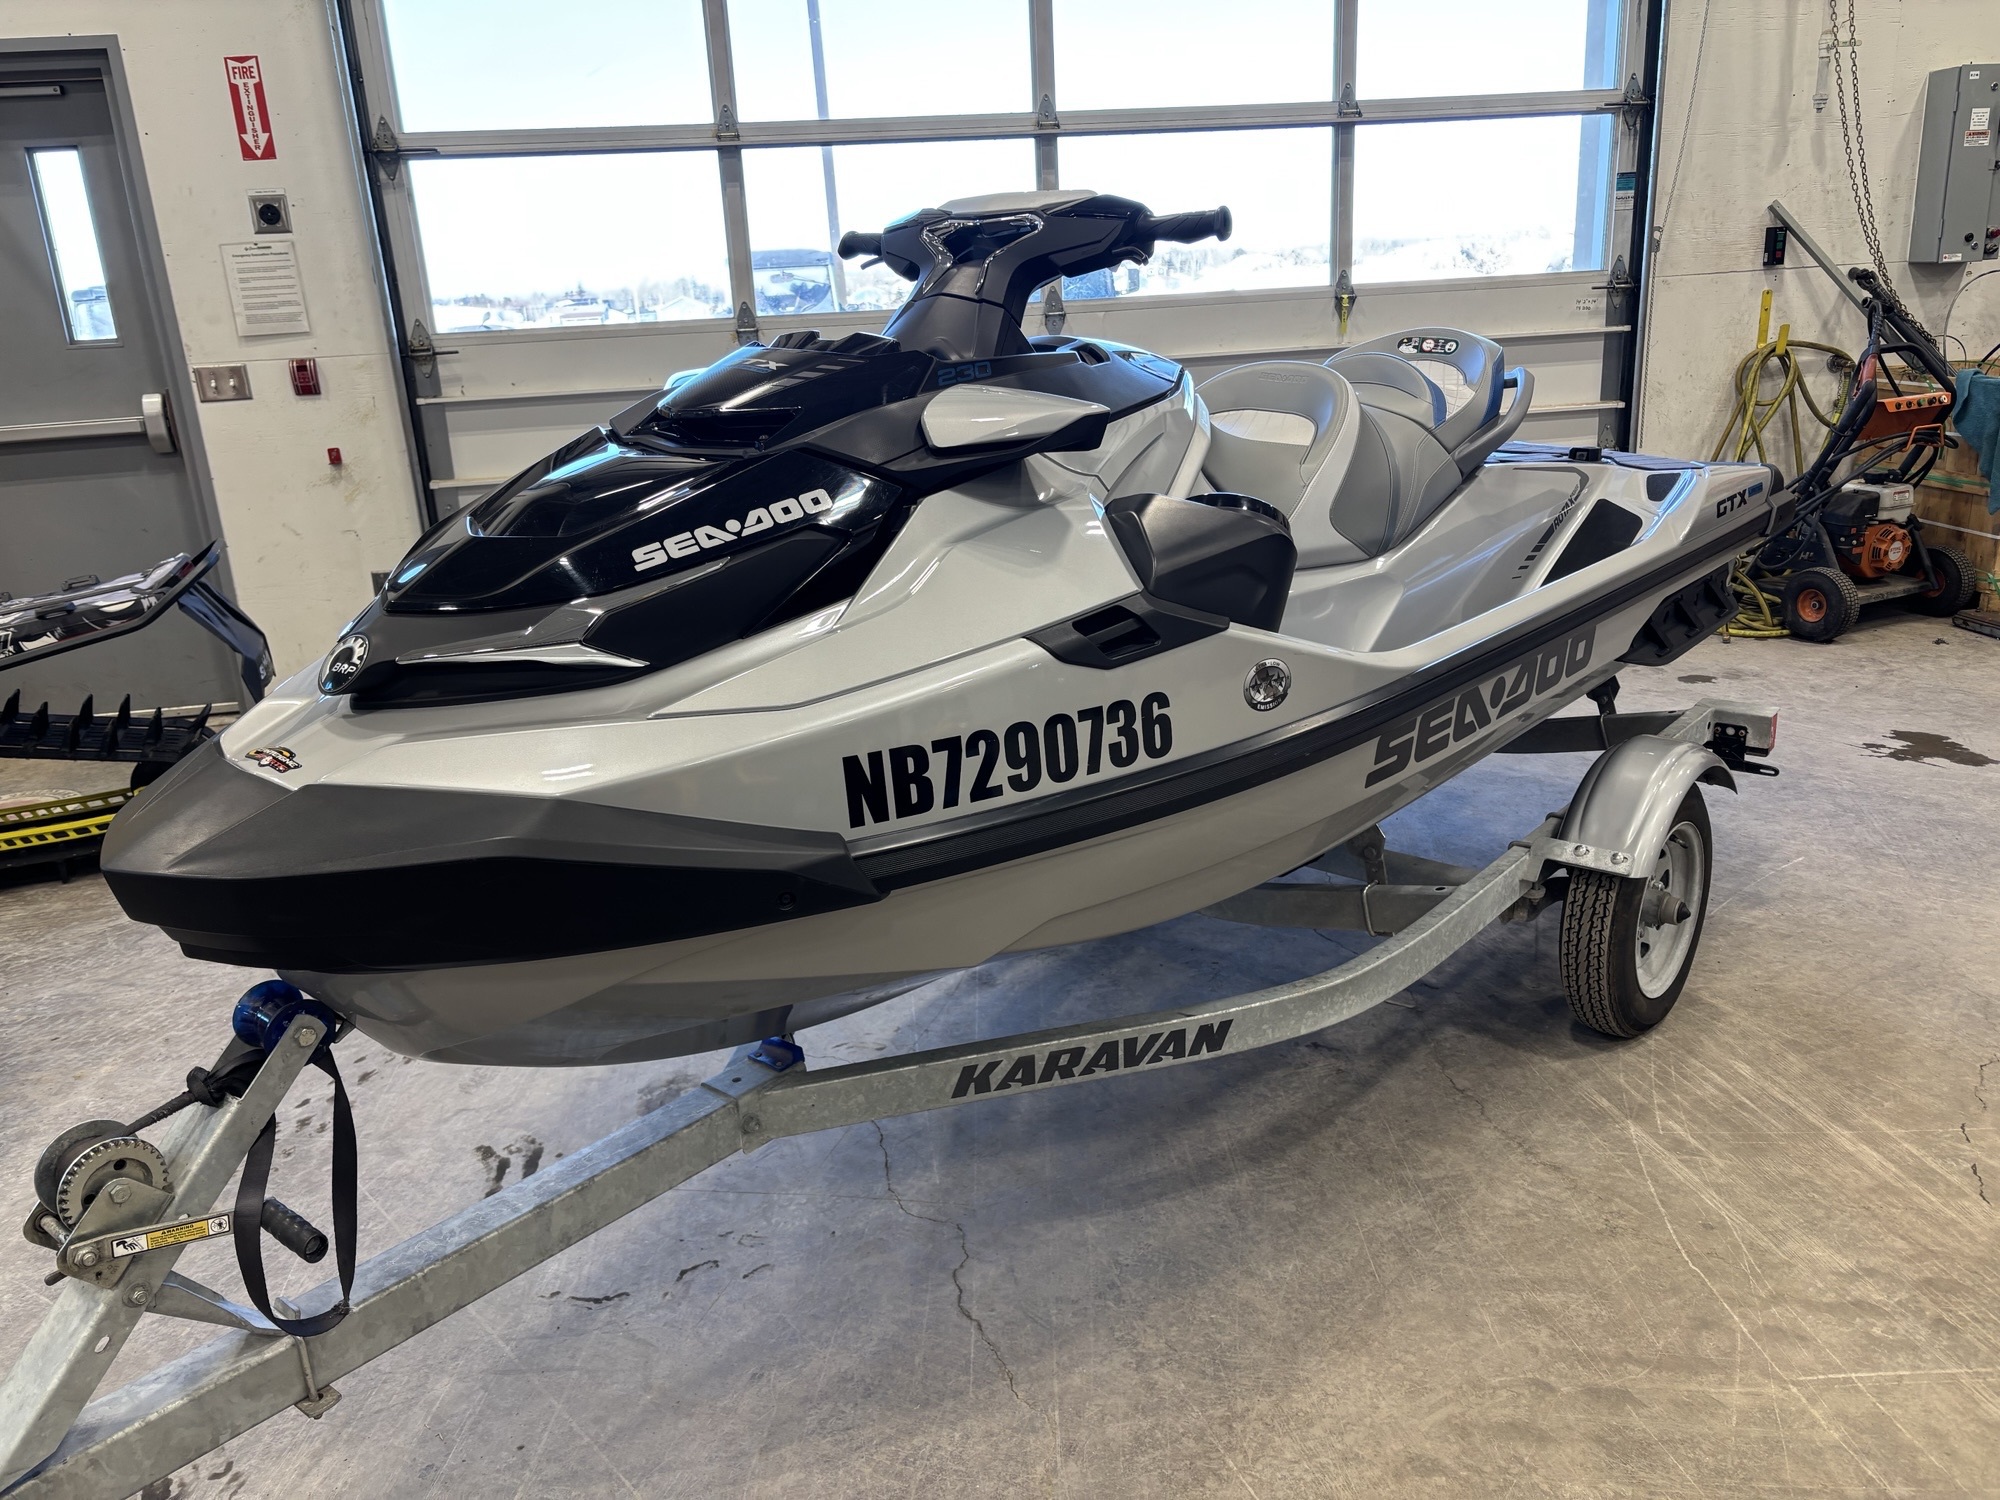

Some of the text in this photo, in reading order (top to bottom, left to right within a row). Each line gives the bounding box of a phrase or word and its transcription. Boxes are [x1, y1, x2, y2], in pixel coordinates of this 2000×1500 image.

[231, 65, 256, 80] FIRE
[243, 81, 261, 151] EXTINGUISHER
[937, 361, 992, 386] 230
[1553, 497, 1576, 531] ROTAX
[1716, 488, 1748, 519] GTX
[331, 662, 357, 675] BRP
[1256, 697, 1283, 710] EMISSION
[841, 691, 1174, 830] NB7290736
[950, 1018, 1235, 1100] KARAVAN
[165, 1224, 194, 1236] WARNING
